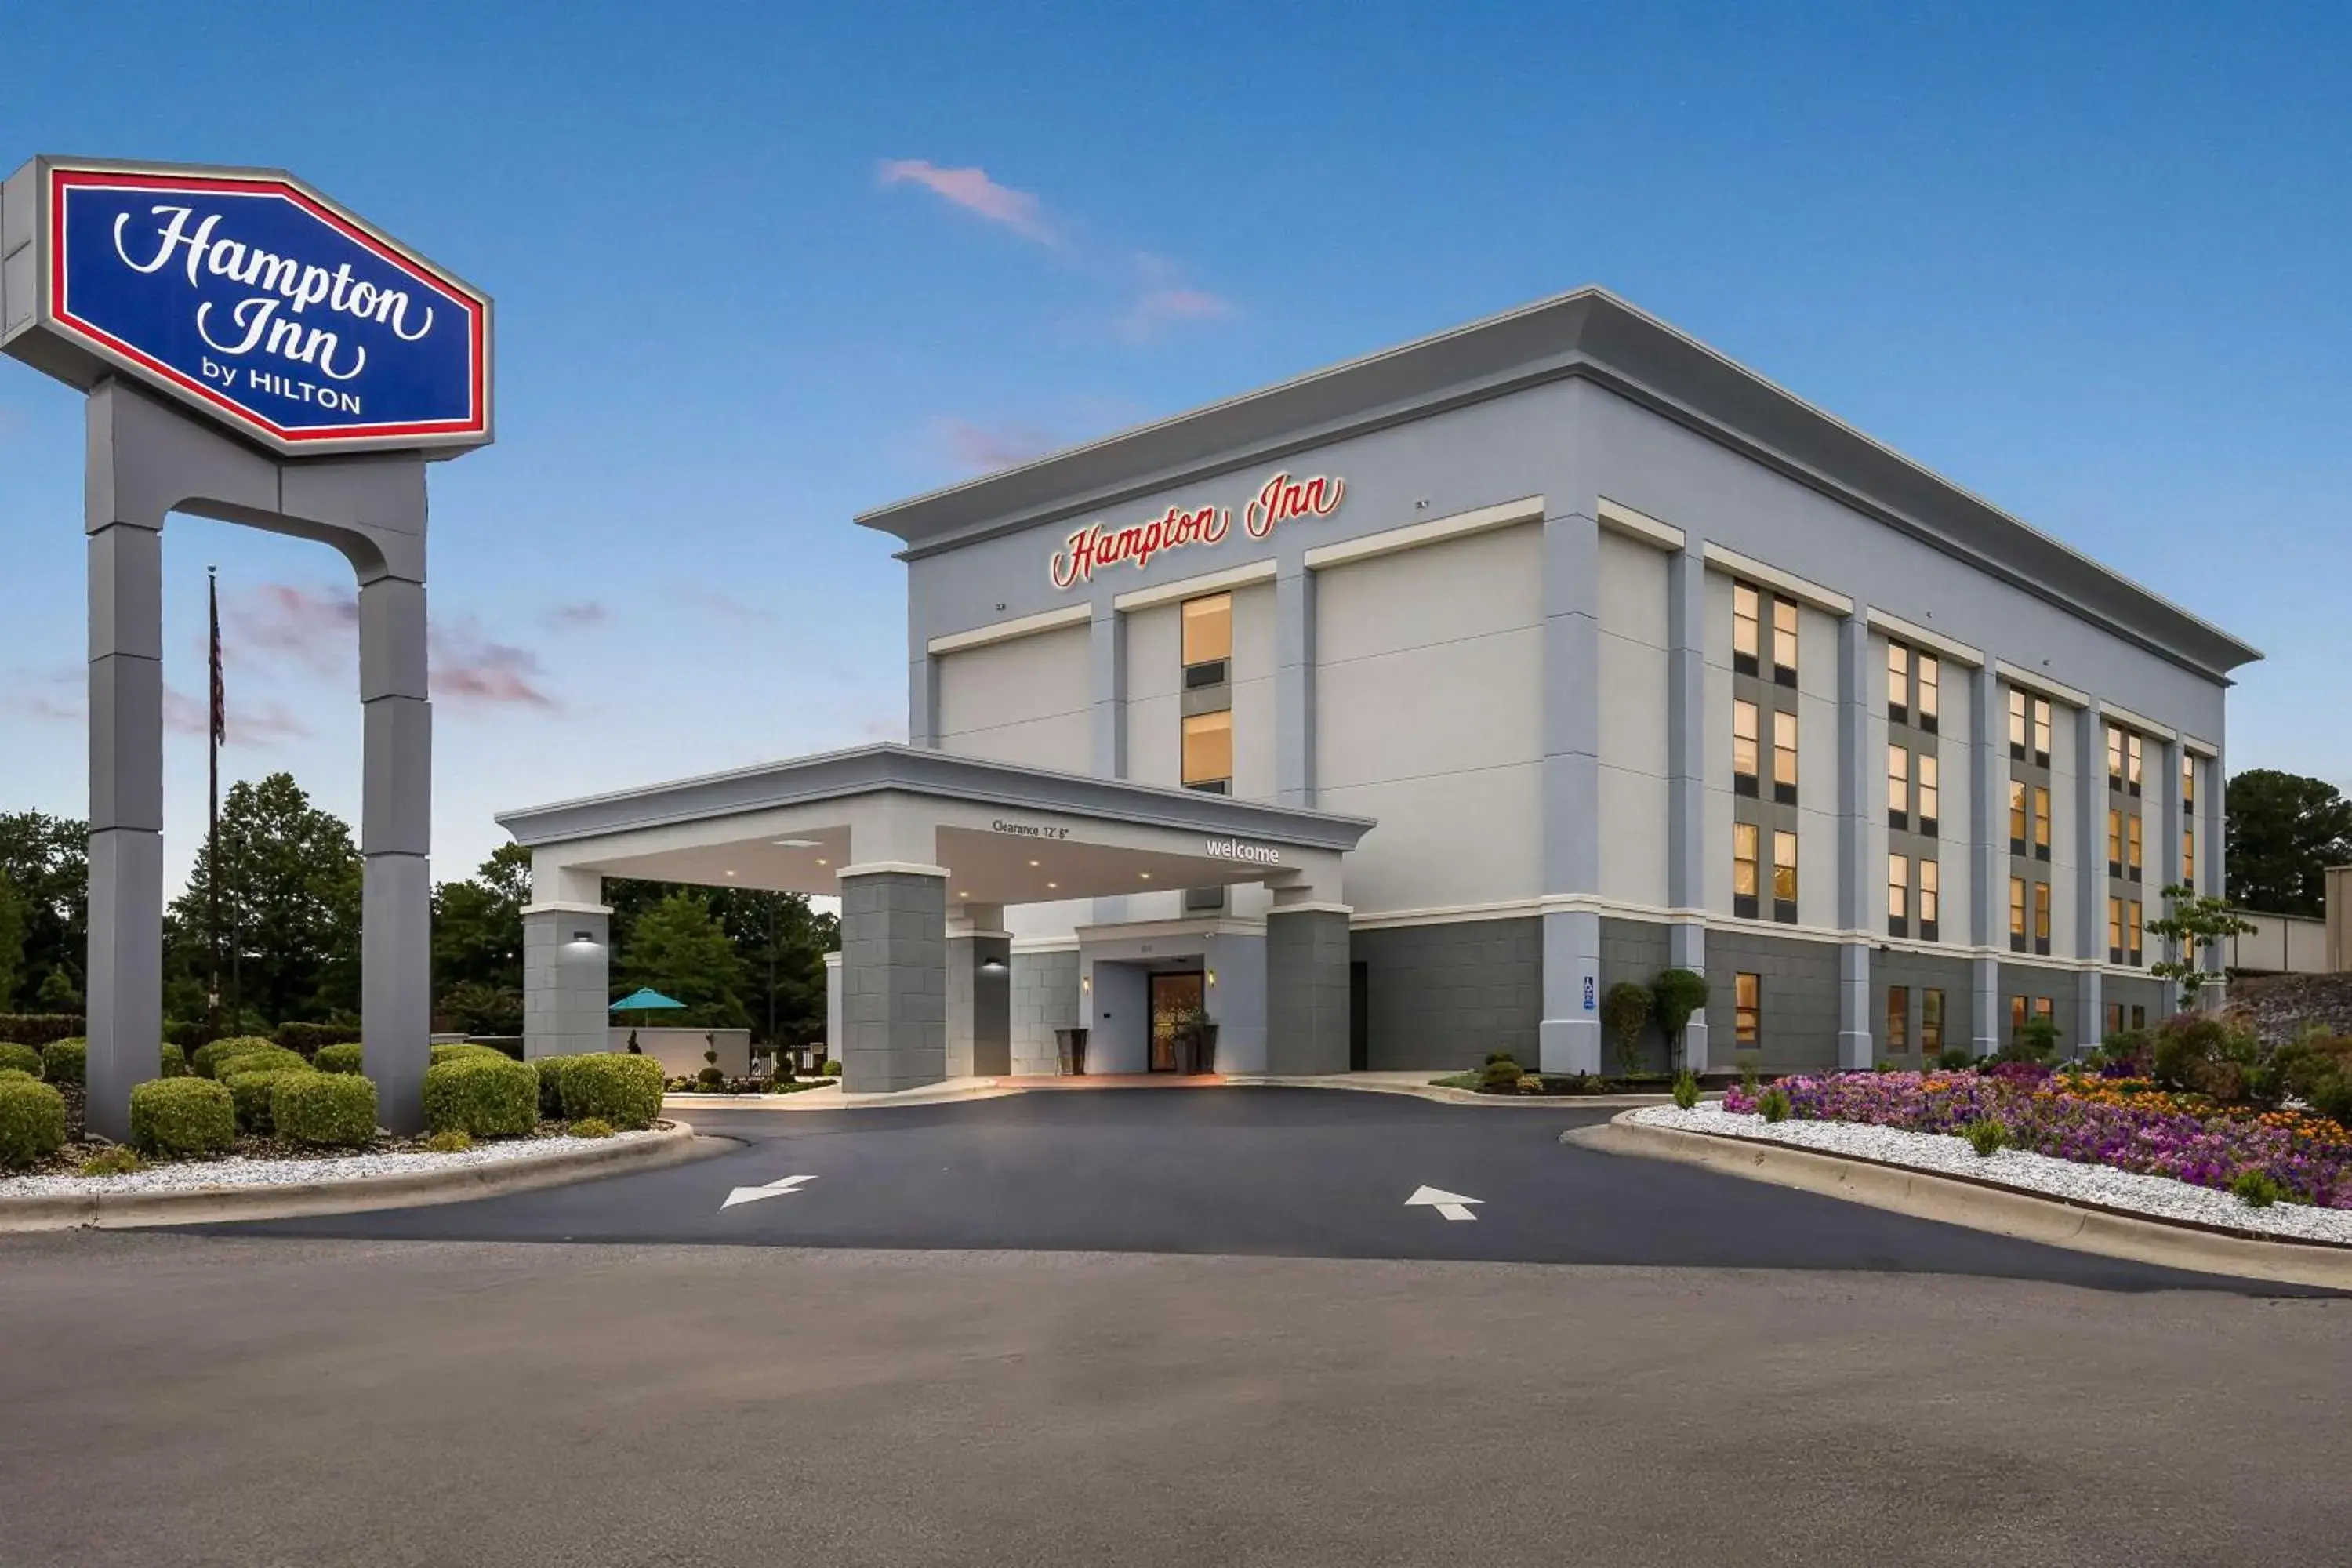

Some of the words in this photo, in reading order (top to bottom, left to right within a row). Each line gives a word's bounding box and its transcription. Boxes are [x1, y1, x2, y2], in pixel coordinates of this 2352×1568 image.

[114, 205, 434, 341] Hampton
[197, 298, 366, 380] Inn
[202, 356, 238, 387] by
[250, 369, 361, 415] HILTON
[1051, 505, 1229, 589] Hampton
[1246, 473, 1345, 539] Inn
[1206, 837, 1279, 864] welcome
